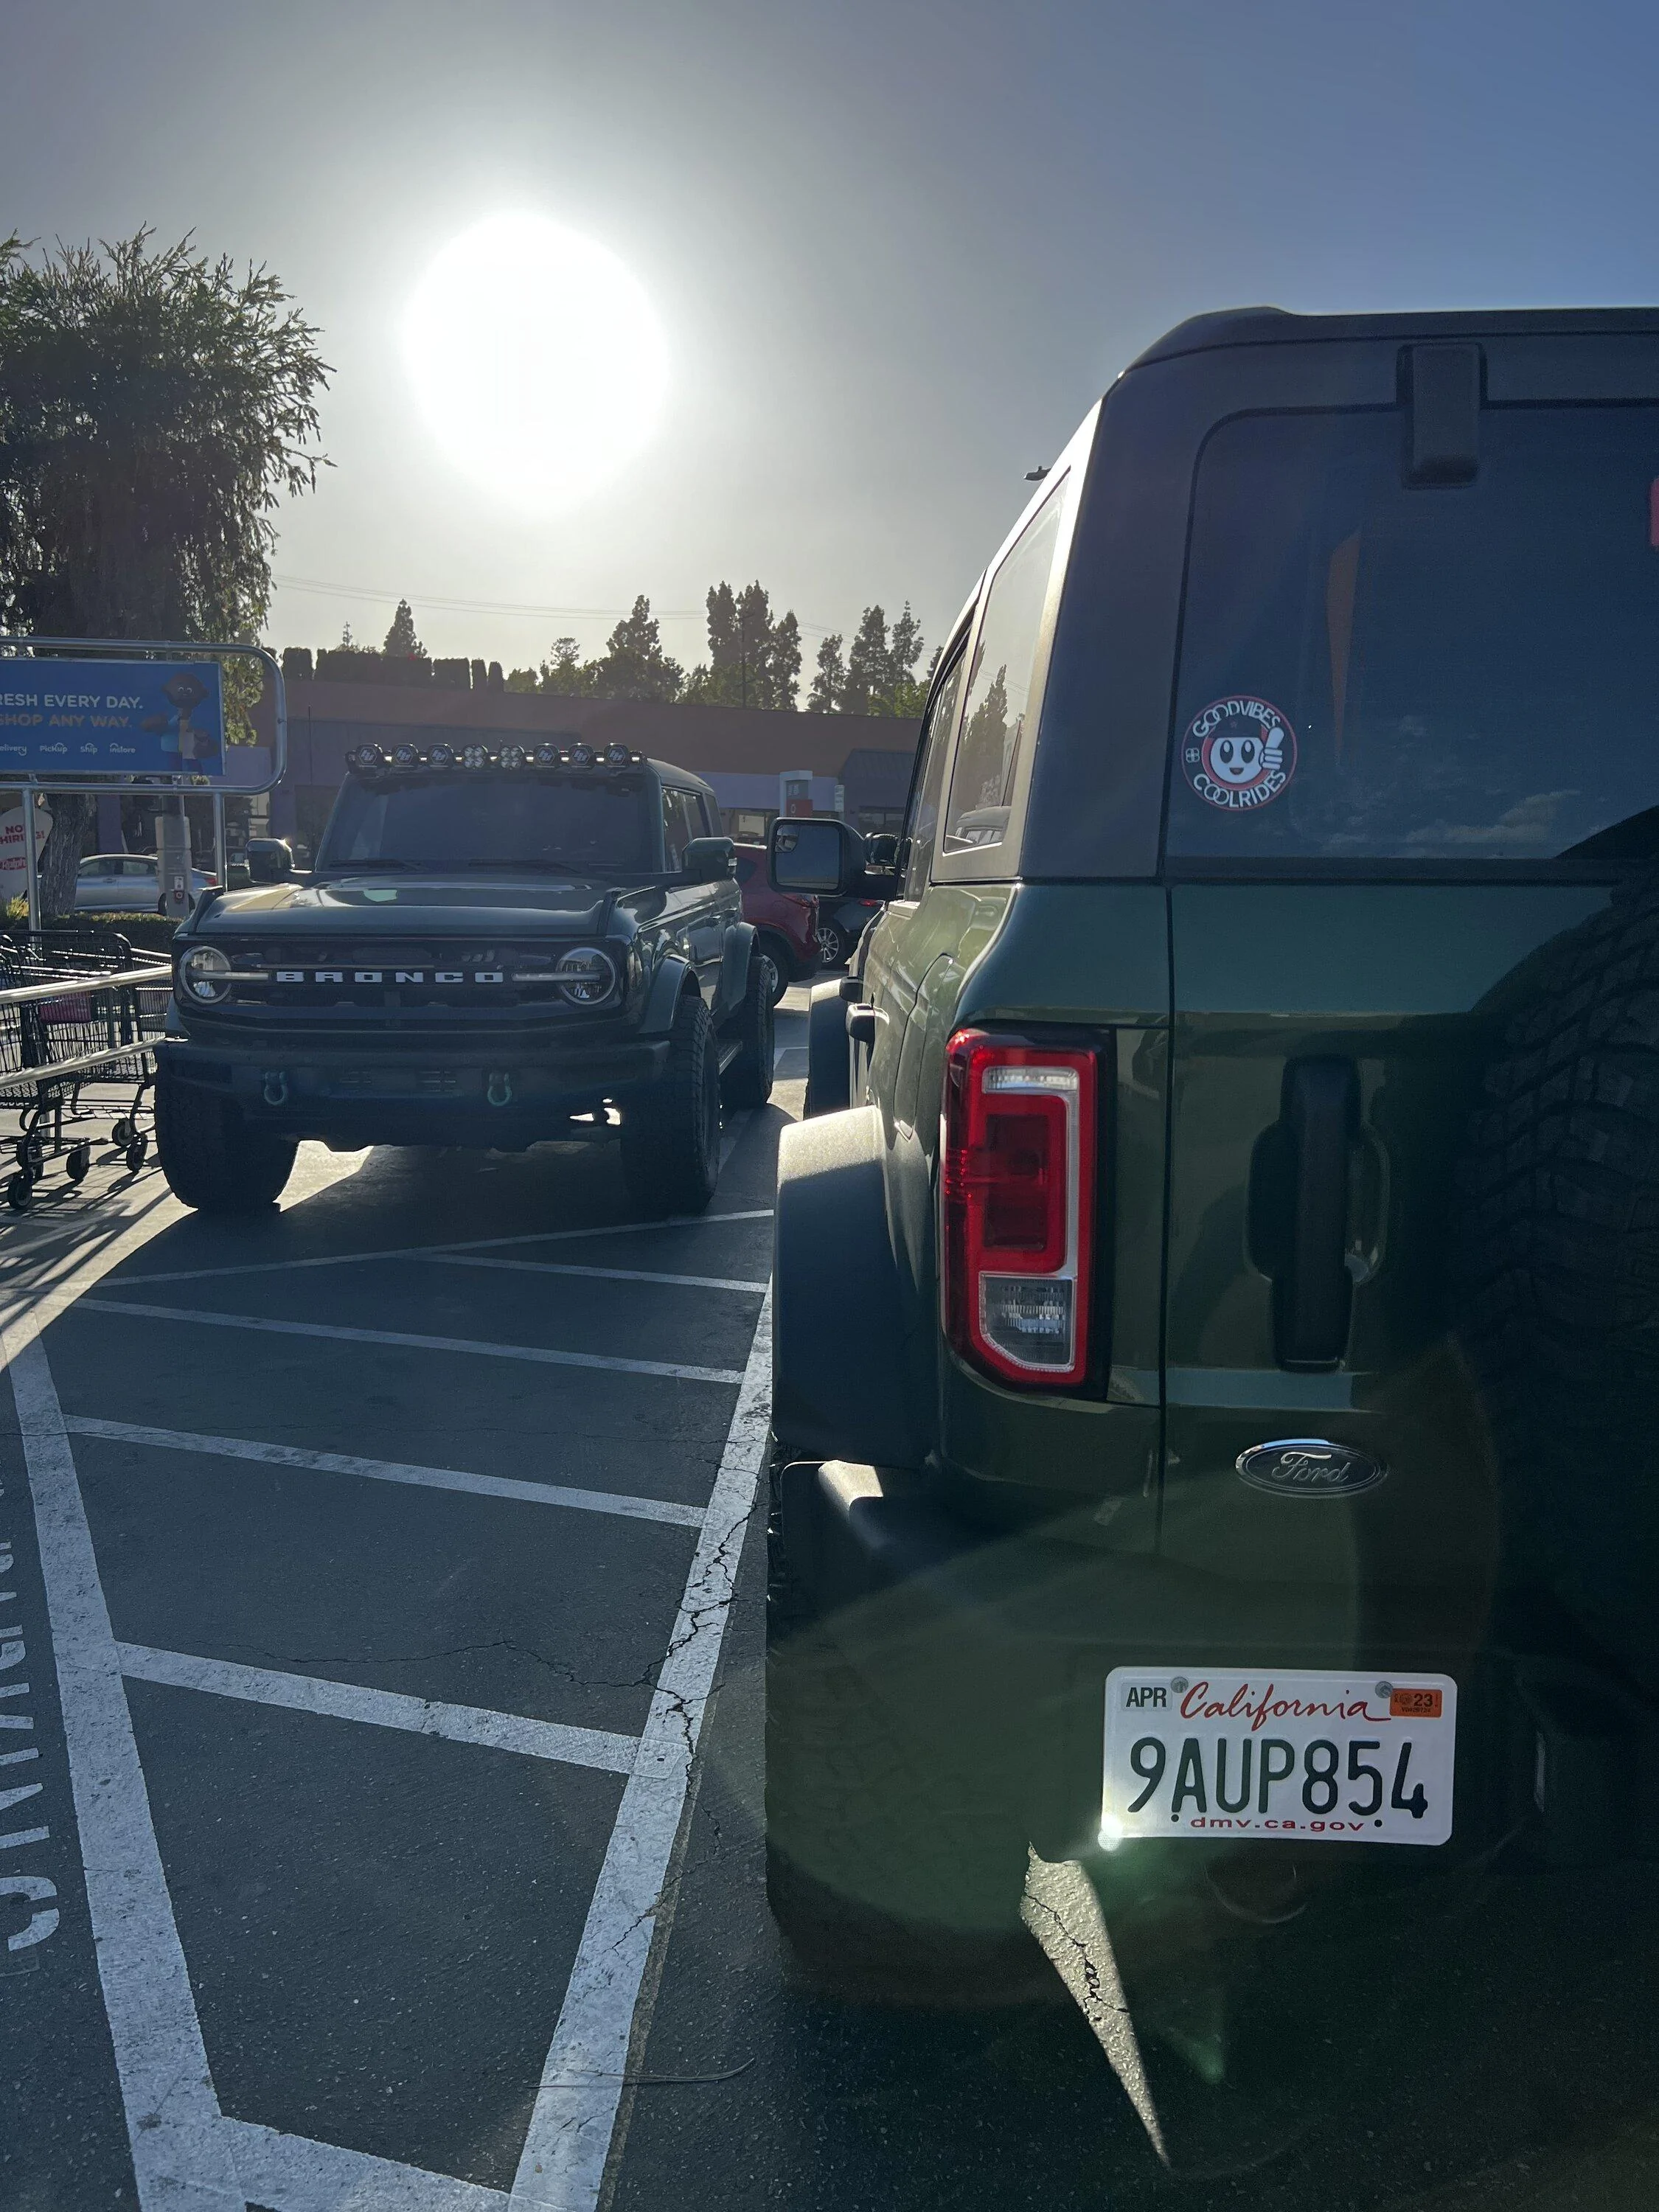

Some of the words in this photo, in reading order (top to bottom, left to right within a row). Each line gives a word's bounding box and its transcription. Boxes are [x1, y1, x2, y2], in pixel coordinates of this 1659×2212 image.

[44, 695, 100, 708] EVERY
[106, 696, 143, 709] DAY.
[49, 714, 85, 727] ANY
[90, 715, 133, 727] WAY.
[276, 971, 504, 983] BRONCO
[1271, 1451, 1351, 1483] Ford
[1125, 1686, 1167, 1708] APR
[1413, 1693, 1433, 1708] 23
[1180, 1681, 1391, 1732] California
[1127, 1736, 1429, 1819] 9AUP854
[1190, 1815, 1365, 1832] dmv.ca.gov
